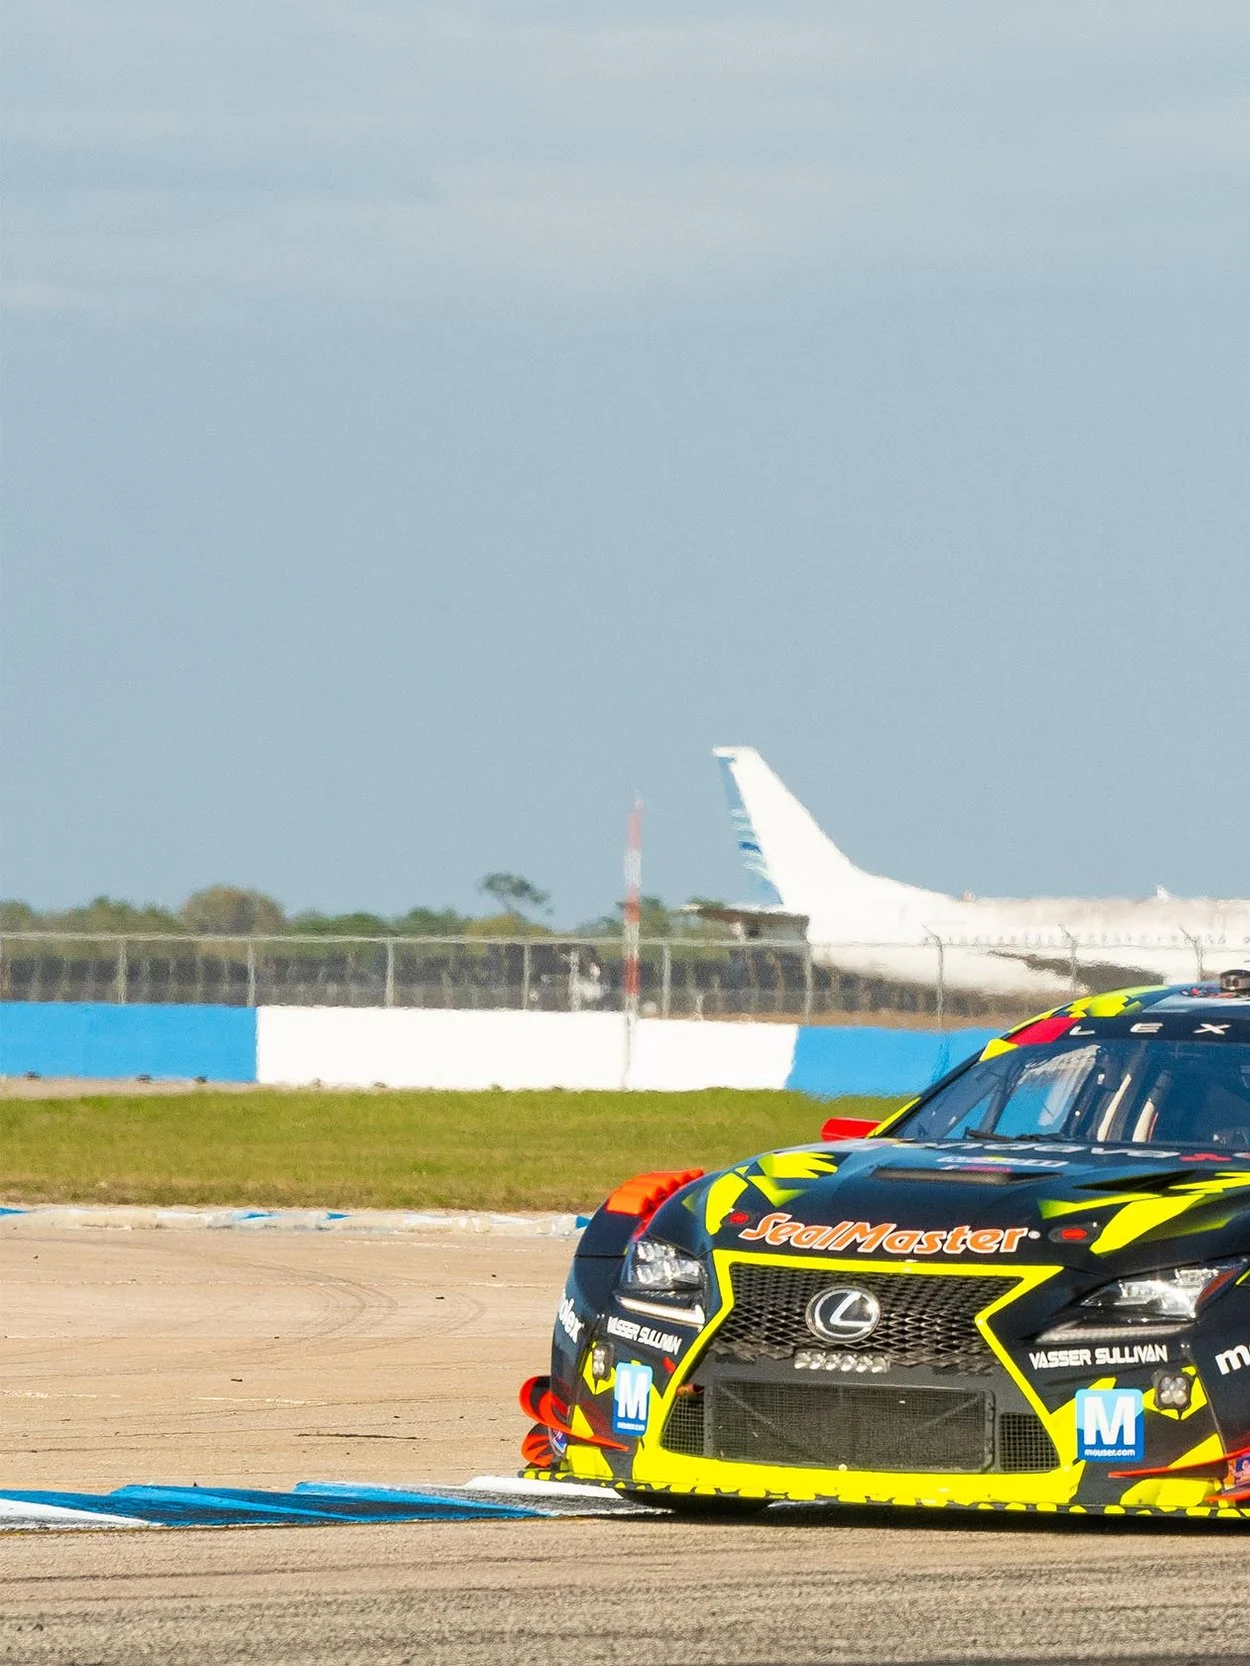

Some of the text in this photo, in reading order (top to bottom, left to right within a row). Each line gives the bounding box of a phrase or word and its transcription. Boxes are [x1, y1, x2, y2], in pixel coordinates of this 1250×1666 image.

[738, 1212, 1029, 1255] SealMaster
[558, 1289, 582, 1344] olex
[1029, 1344, 1168, 1370] VASSER SULLIVAN
[617, 1369, 649, 1421] M
[1083, 1396, 1136, 1446] M
[1084, 1448, 1136, 1457] mouser.com
